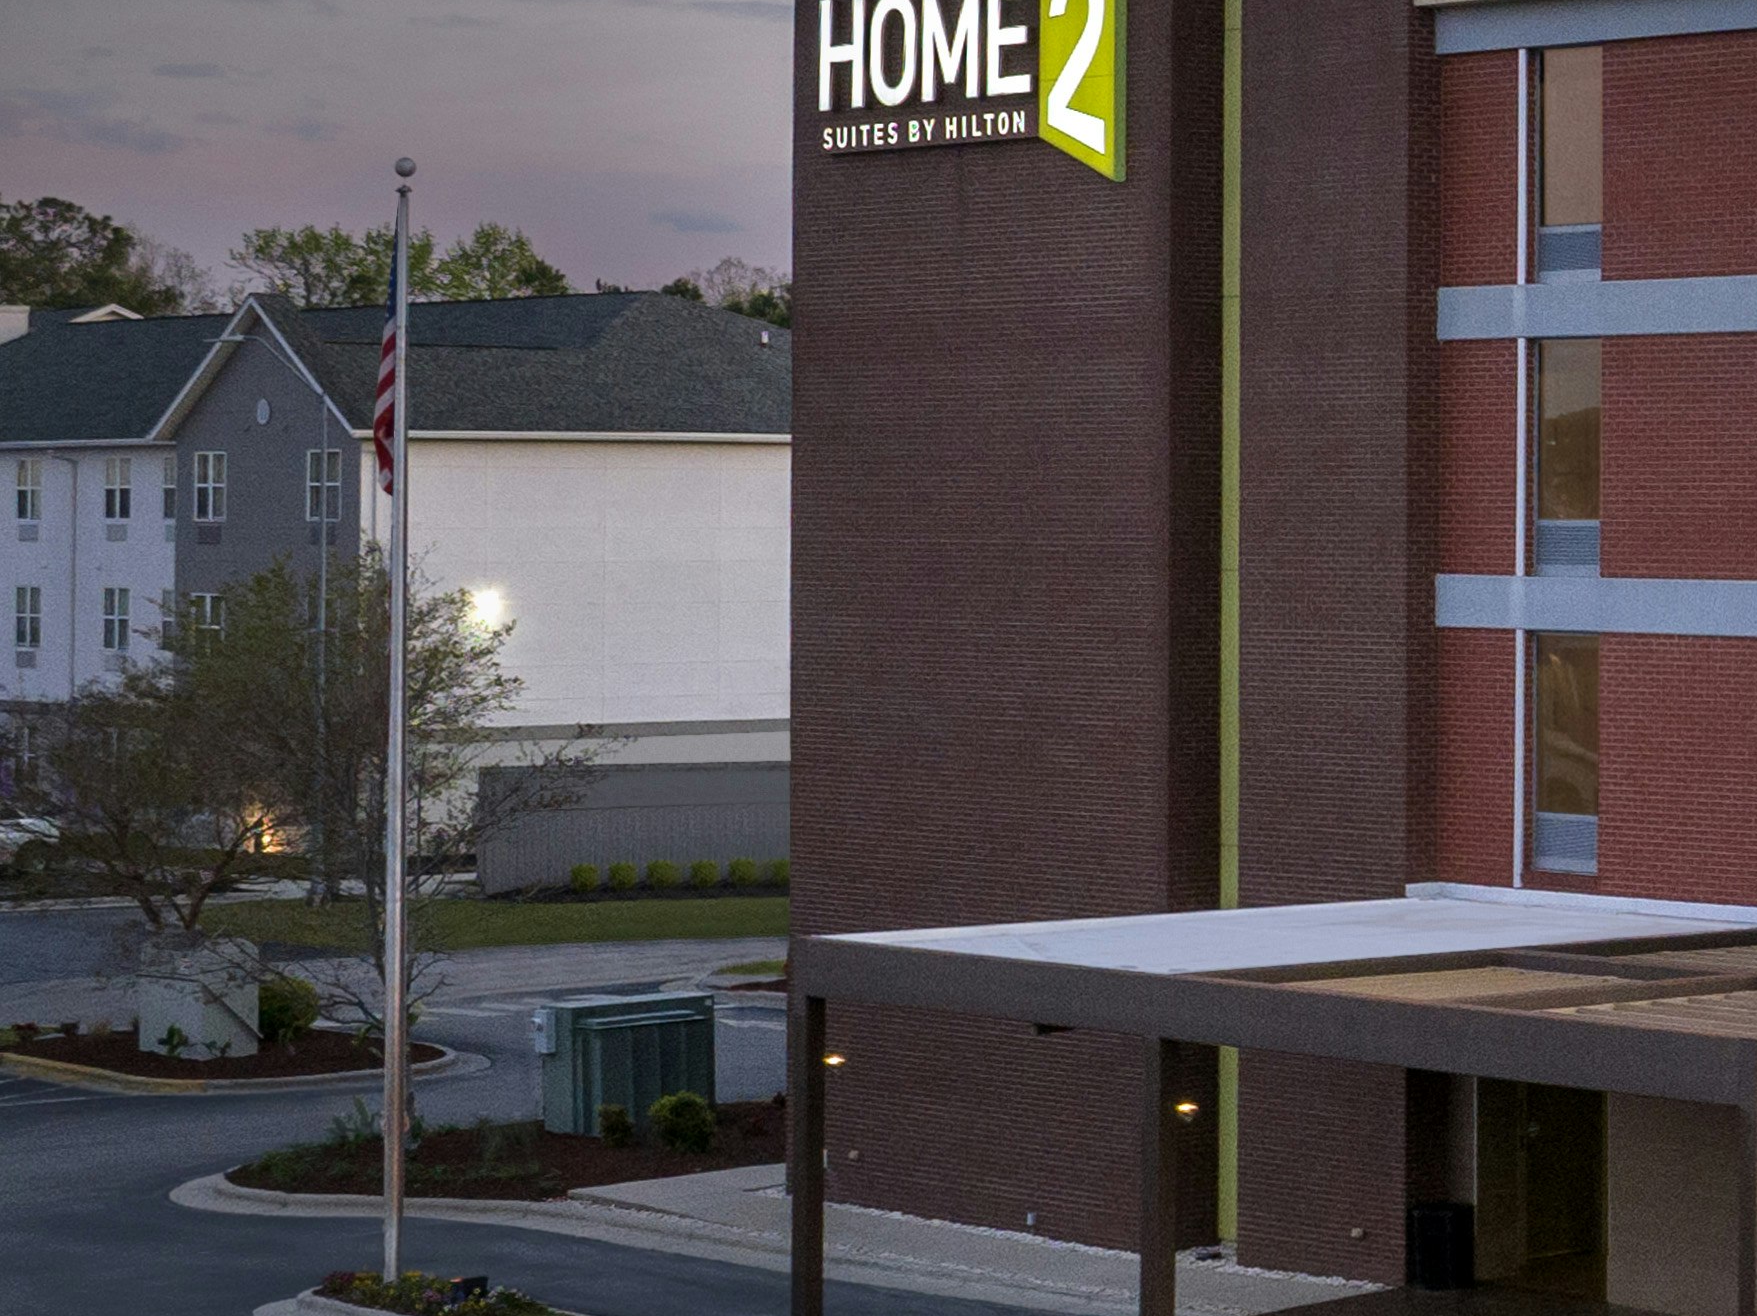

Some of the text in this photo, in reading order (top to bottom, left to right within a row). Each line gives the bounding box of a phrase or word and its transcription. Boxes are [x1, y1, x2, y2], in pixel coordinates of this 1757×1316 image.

[822, 110, 1026, 150] SUITES BY HILTON
